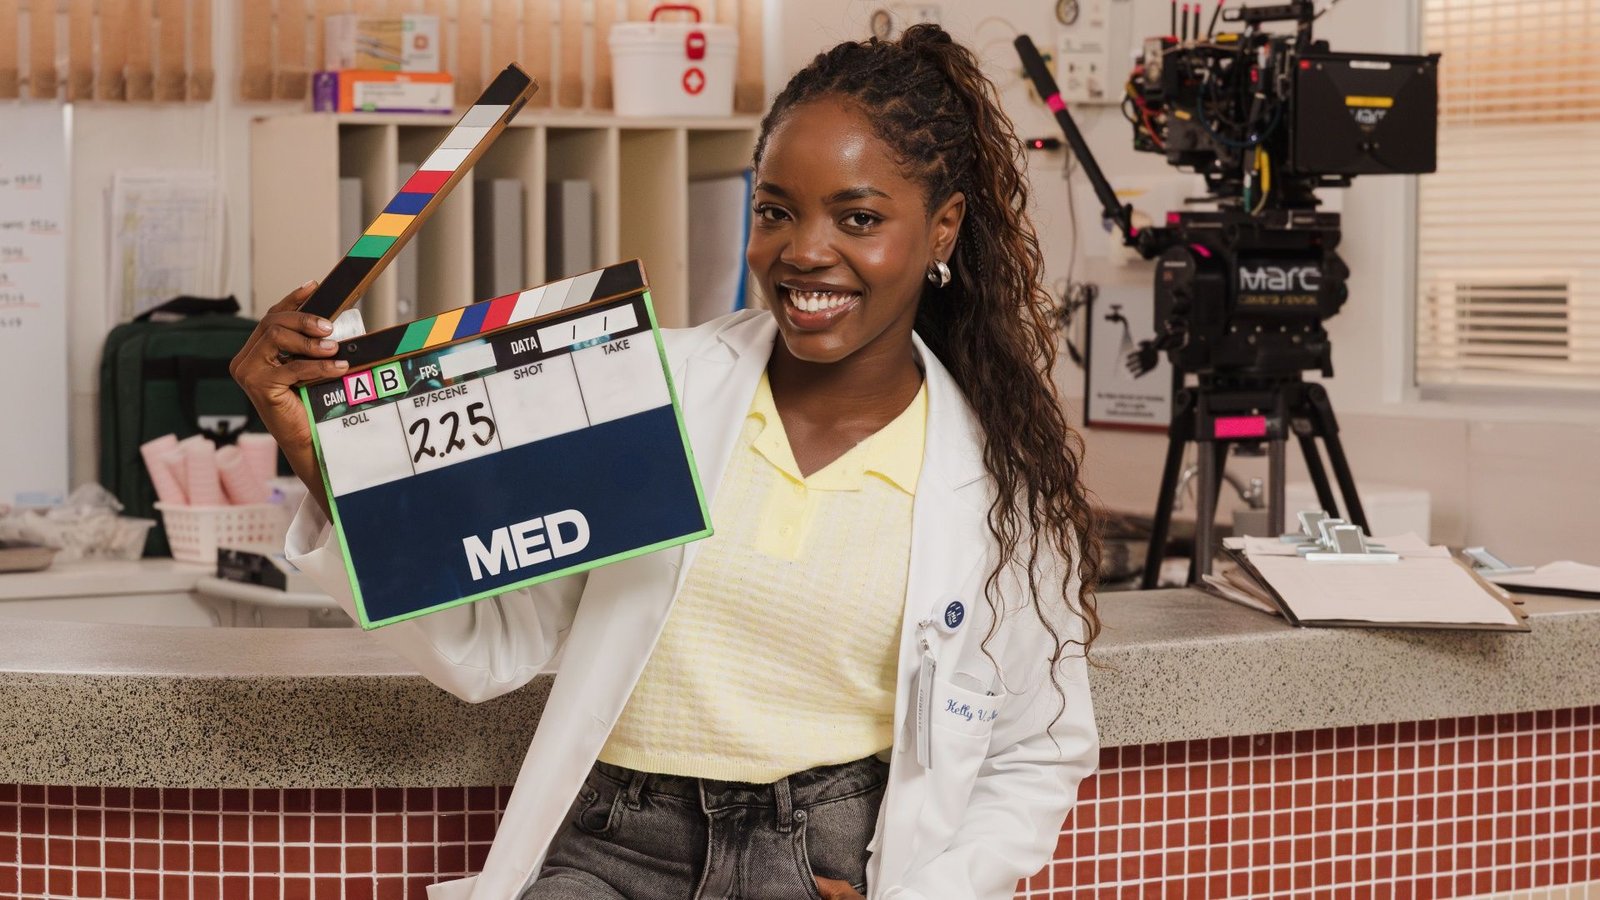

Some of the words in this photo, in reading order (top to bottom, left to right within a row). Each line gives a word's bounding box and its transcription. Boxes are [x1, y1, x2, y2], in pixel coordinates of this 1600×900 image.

[510, 336, 538, 355] DATA
[602, 339, 631, 356] TAKE
[419, 364, 438, 380] FPS
[513, 363, 543, 380] SHOT
[323, 389, 346, 406] CAM
[353, 377, 371, 400] A
[379, 369, 399, 392] B
[413, 384, 468, 408] EP/SCENE
[342, 412, 370, 428] ROLL
[409, 402, 496, 463] 2.25
[462, 508, 590, 581] MED
[944, 698, 973, 722] Kelly
